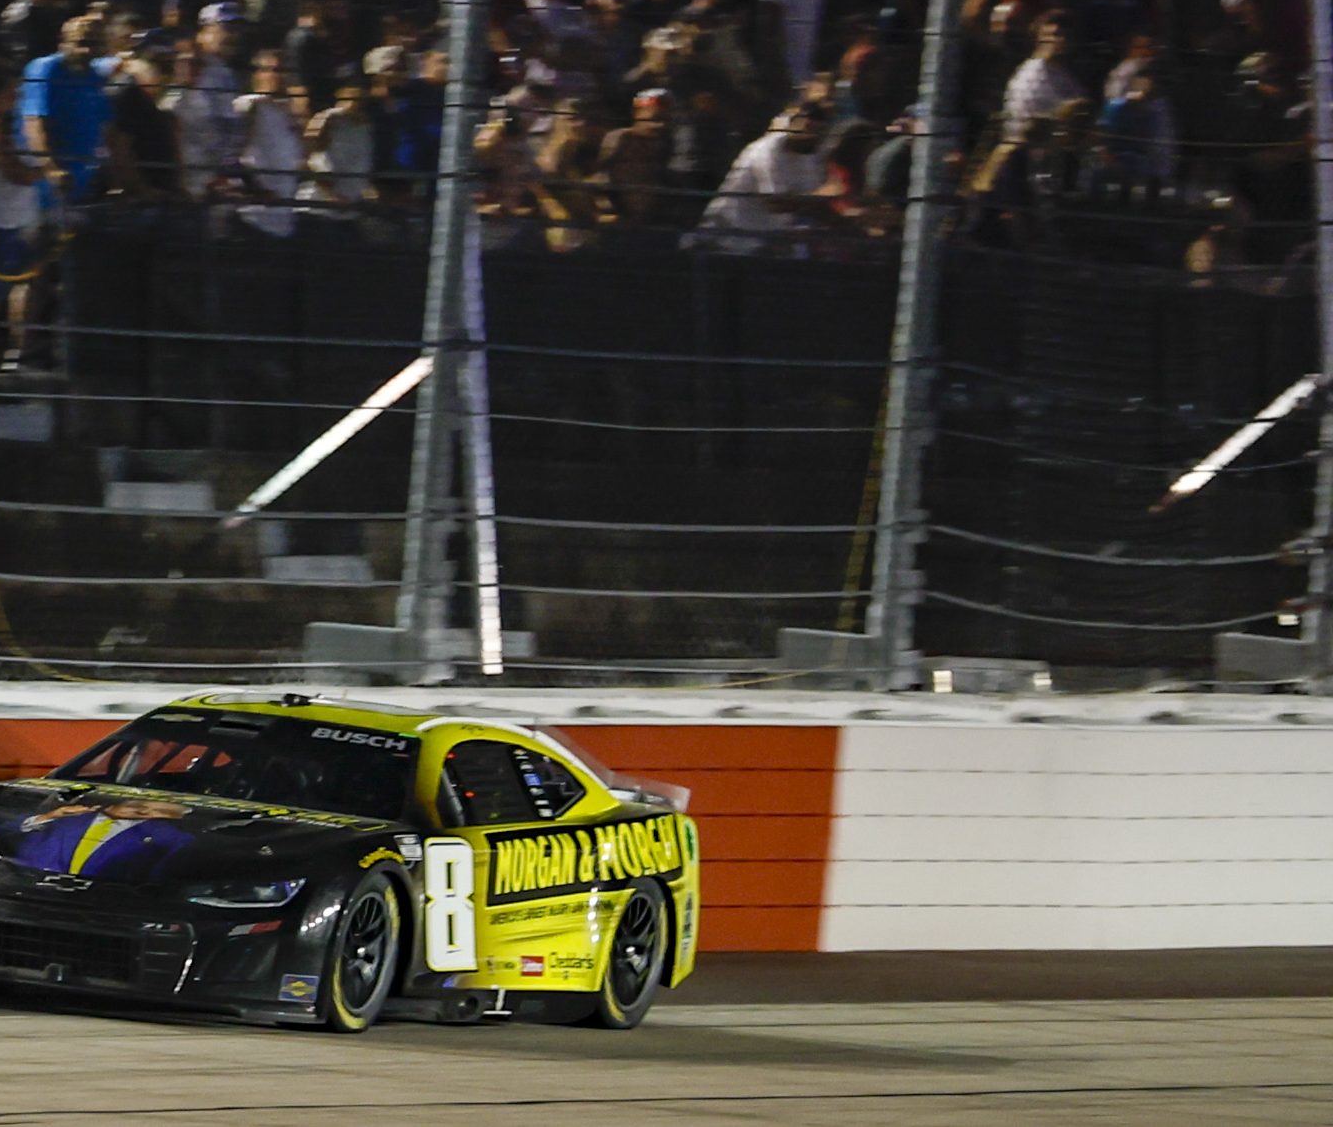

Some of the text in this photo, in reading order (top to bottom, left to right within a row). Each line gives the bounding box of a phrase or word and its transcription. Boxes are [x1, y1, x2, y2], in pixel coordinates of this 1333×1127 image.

[311, 727, 408, 751] BUSCH
[494, 832, 577, 895] MORGAN
[576, 830, 595, 883] &
[425, 837, 478, 972] 8
